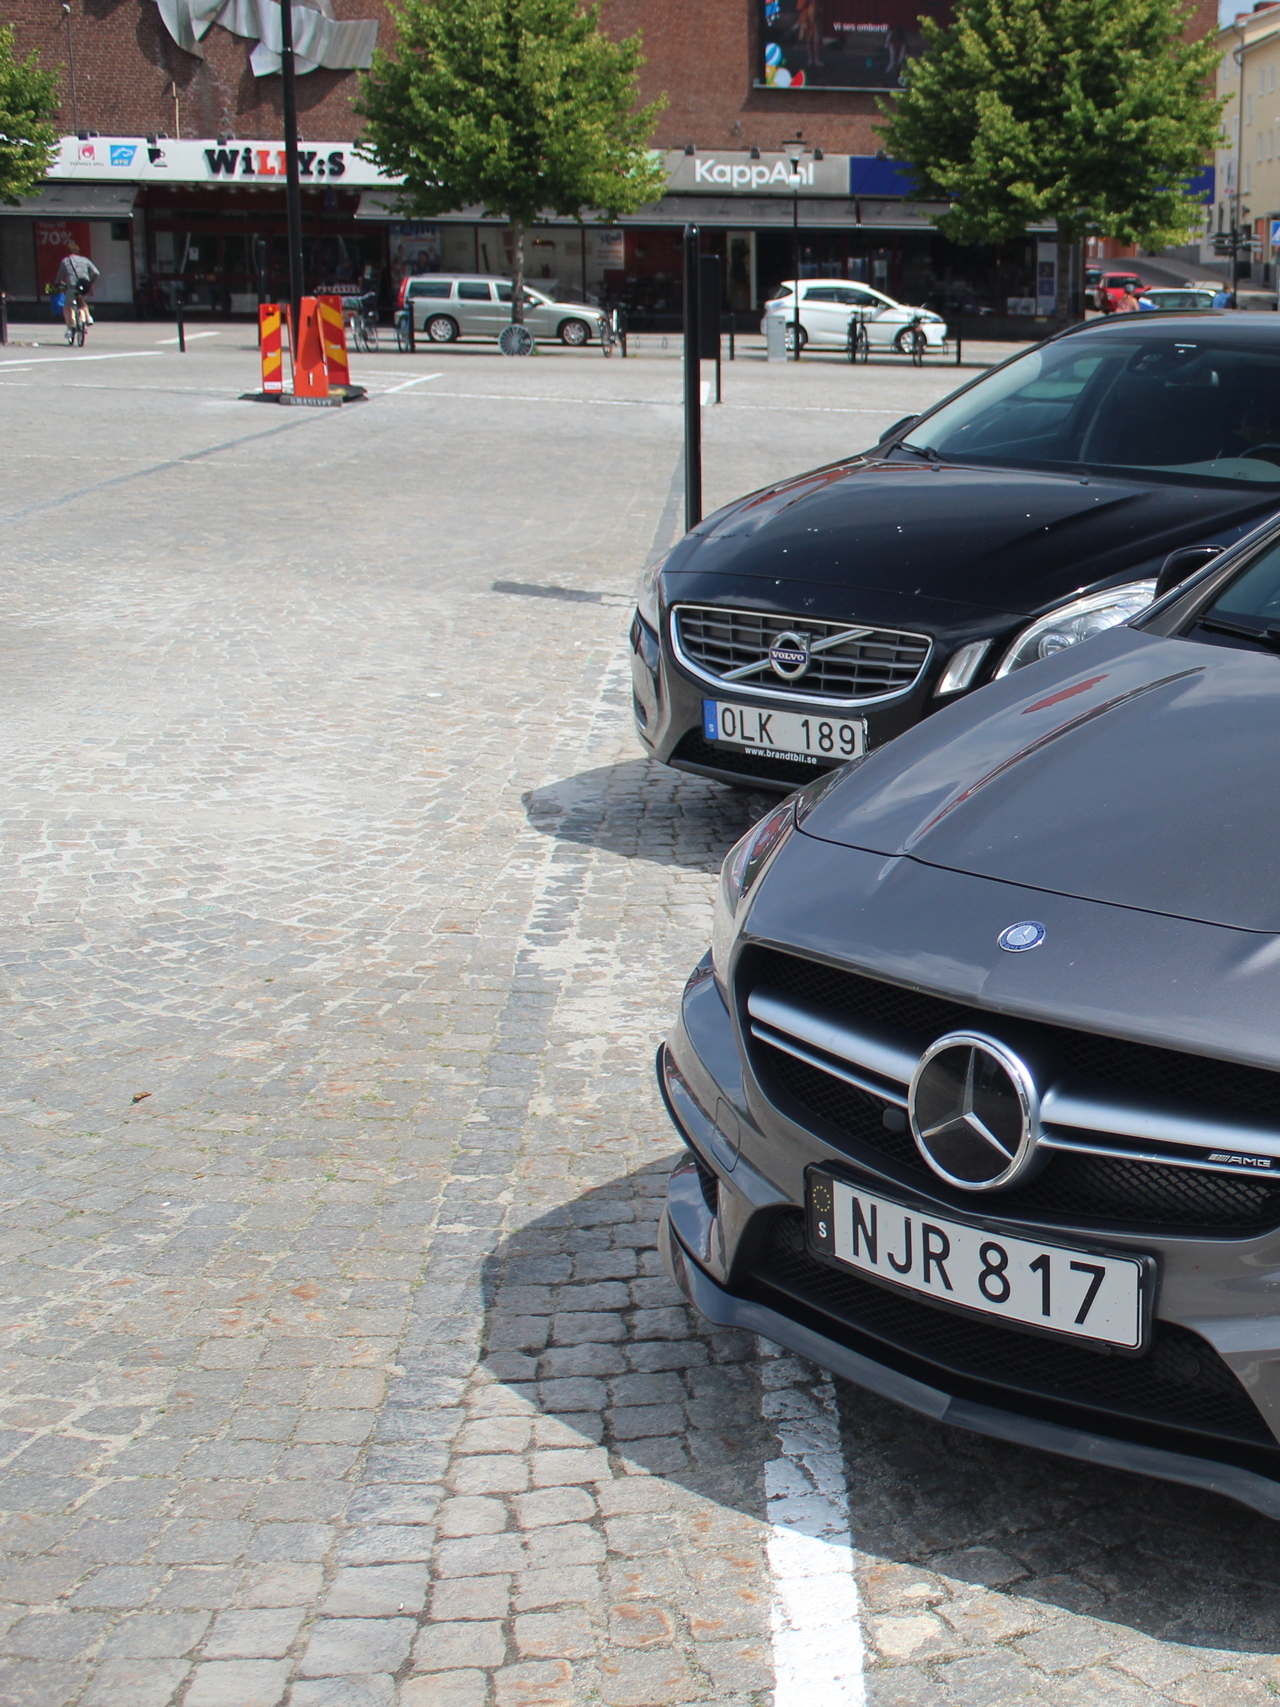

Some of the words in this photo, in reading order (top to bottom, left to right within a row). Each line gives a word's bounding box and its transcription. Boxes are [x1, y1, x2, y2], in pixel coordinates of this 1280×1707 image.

[833, 22, 841, 31] Vi
[857, 23, 888, 33] ombord!
[695, 159, 814, 189] KappAhl
[40, 231, 75, 245] 70%
[771, 650, 804, 661] VOLVO
[709, 723, 715, 732] S
[721, 707, 774, 745] OLK
[801, 719, 855, 755] 189
[744, 746, 818, 765] www.brandtbil.se
[1228, 1156, 1271, 1168] AMG
[818, 1221, 827, 1238] S
[852, 1196, 954, 1291] NJR
[978, 1241, 1106, 1325] 817
